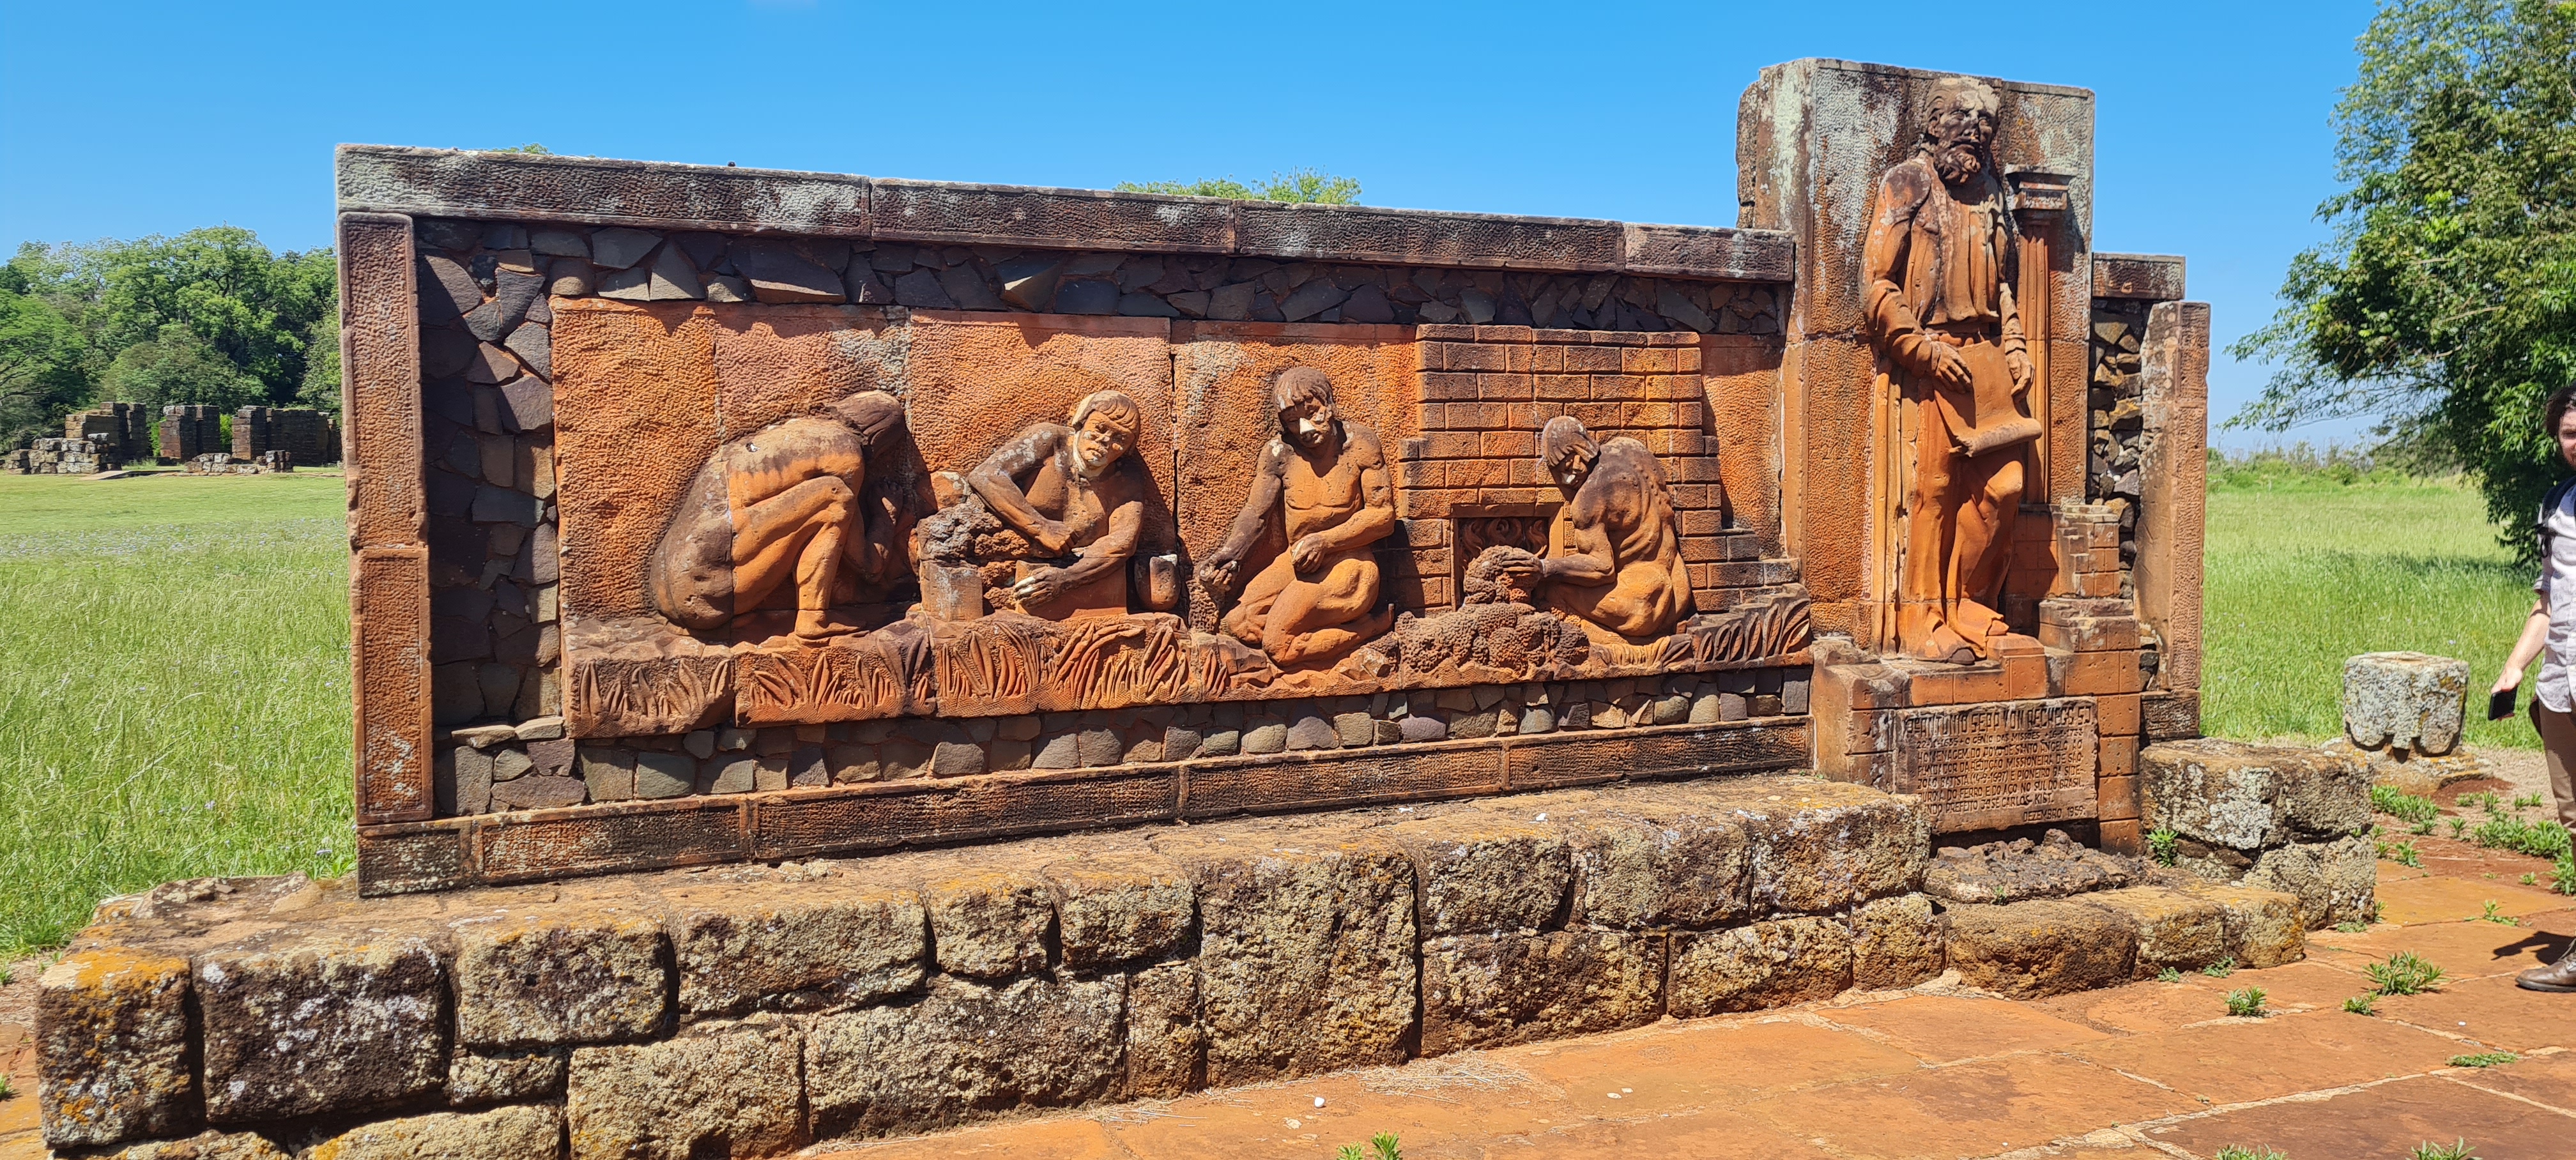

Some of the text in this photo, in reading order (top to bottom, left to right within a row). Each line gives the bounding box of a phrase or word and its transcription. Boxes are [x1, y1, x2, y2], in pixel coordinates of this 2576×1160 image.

[1972, 712, 1999, 733] SEPP
[2004, 710, 2023, 729] VON
[1997, 733, 2009, 742] DAS
[1917, 747, 1970, 761] HOMENAGEM
[1971, 747, 1981, 758] DO
[1983, 746, 2004, 758] POVO
[2005, 745, 2013, 755] DE
[2014, 743, 2038, 754] SANTO
[2073, 739, 2083, 751] AO
[1917, 763, 1958, 775] FUNDADOR
[1960, 761, 1969, 773] DA
[2007, 754, 2053, 768] MISSIONEIRA
[2056, 754, 2066, 765] DE
[1941, 775, 1968, 788] BATISTA
[2011, 770, 2015, 781] E
[2018, 768, 2050, 780] PIONEIRO
[1947, 789, 1957, 801] DO
[1959, 786, 1982, 798] FERRO
[1986, 785, 1991, 796] E
[1992, 785, 2001, 796] DO
[2004, 784, 2017, 795] AÇO
[2021, 782, 2031, 793] NO
[2034, 781, 2047, 791] SUL
[2048, 780, 2057, 790] DO
[1946, 800, 1978, 813] PREFEITO
[2002, 795, 2032, 808] CARLOS
[2023, 808, 2062, 821] DEZEMBRO
